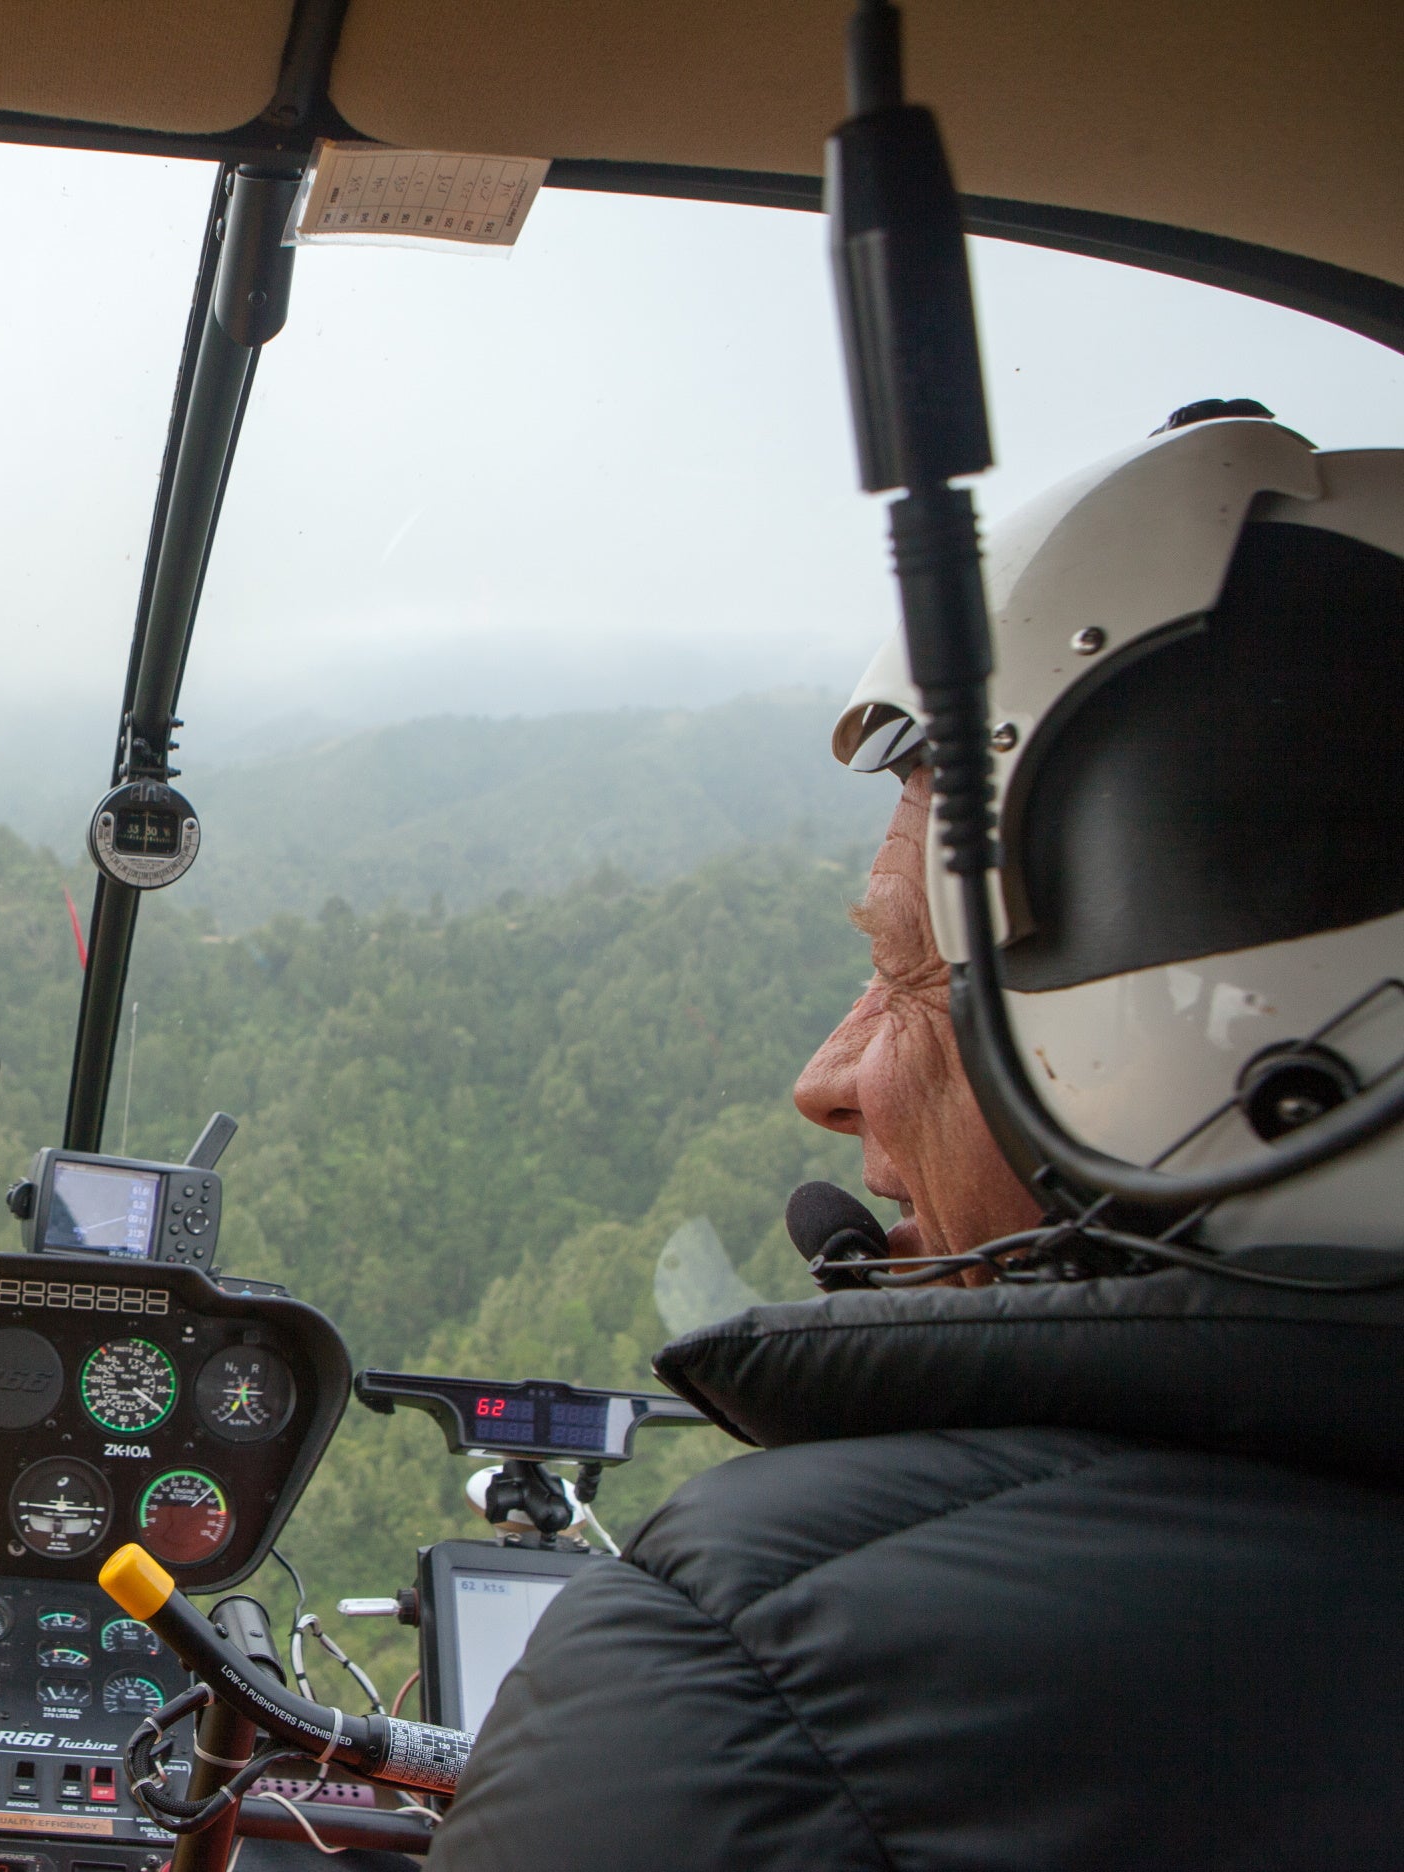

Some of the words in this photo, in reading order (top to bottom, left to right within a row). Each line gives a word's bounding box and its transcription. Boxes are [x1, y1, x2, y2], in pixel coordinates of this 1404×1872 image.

[380, 212, 390, 223] 090
[402, 214, 410, 224] 135
[444, 218, 454, 228] 225
[464, 220, 474, 231] 270
[485, 222, 495, 232] 315
[134, 1348, 143, 1356] 20
[476, 1398, 506, 1417] 62
[461, 1581, 476, 1591] 62
[483, 1582, 506, 1593] kts
[221, 1664, 248, 1692] LOW-G
[246, 1688, 298, 1726] PUSHOVERS
[298, 1720, 352, 1746] PROHIBTED
[57, 1738, 118, 1751] Turbine
[438, 1742, 451, 1750] 130
[410, 1750, 420, 1758] 114
[432, 1762, 442, 1770] 121
[6, 1801, 40, 1810] AVIONICS
[62, 1804, 78, 1812] GEN
[85, 1806, 118, 1814] BATTERY
